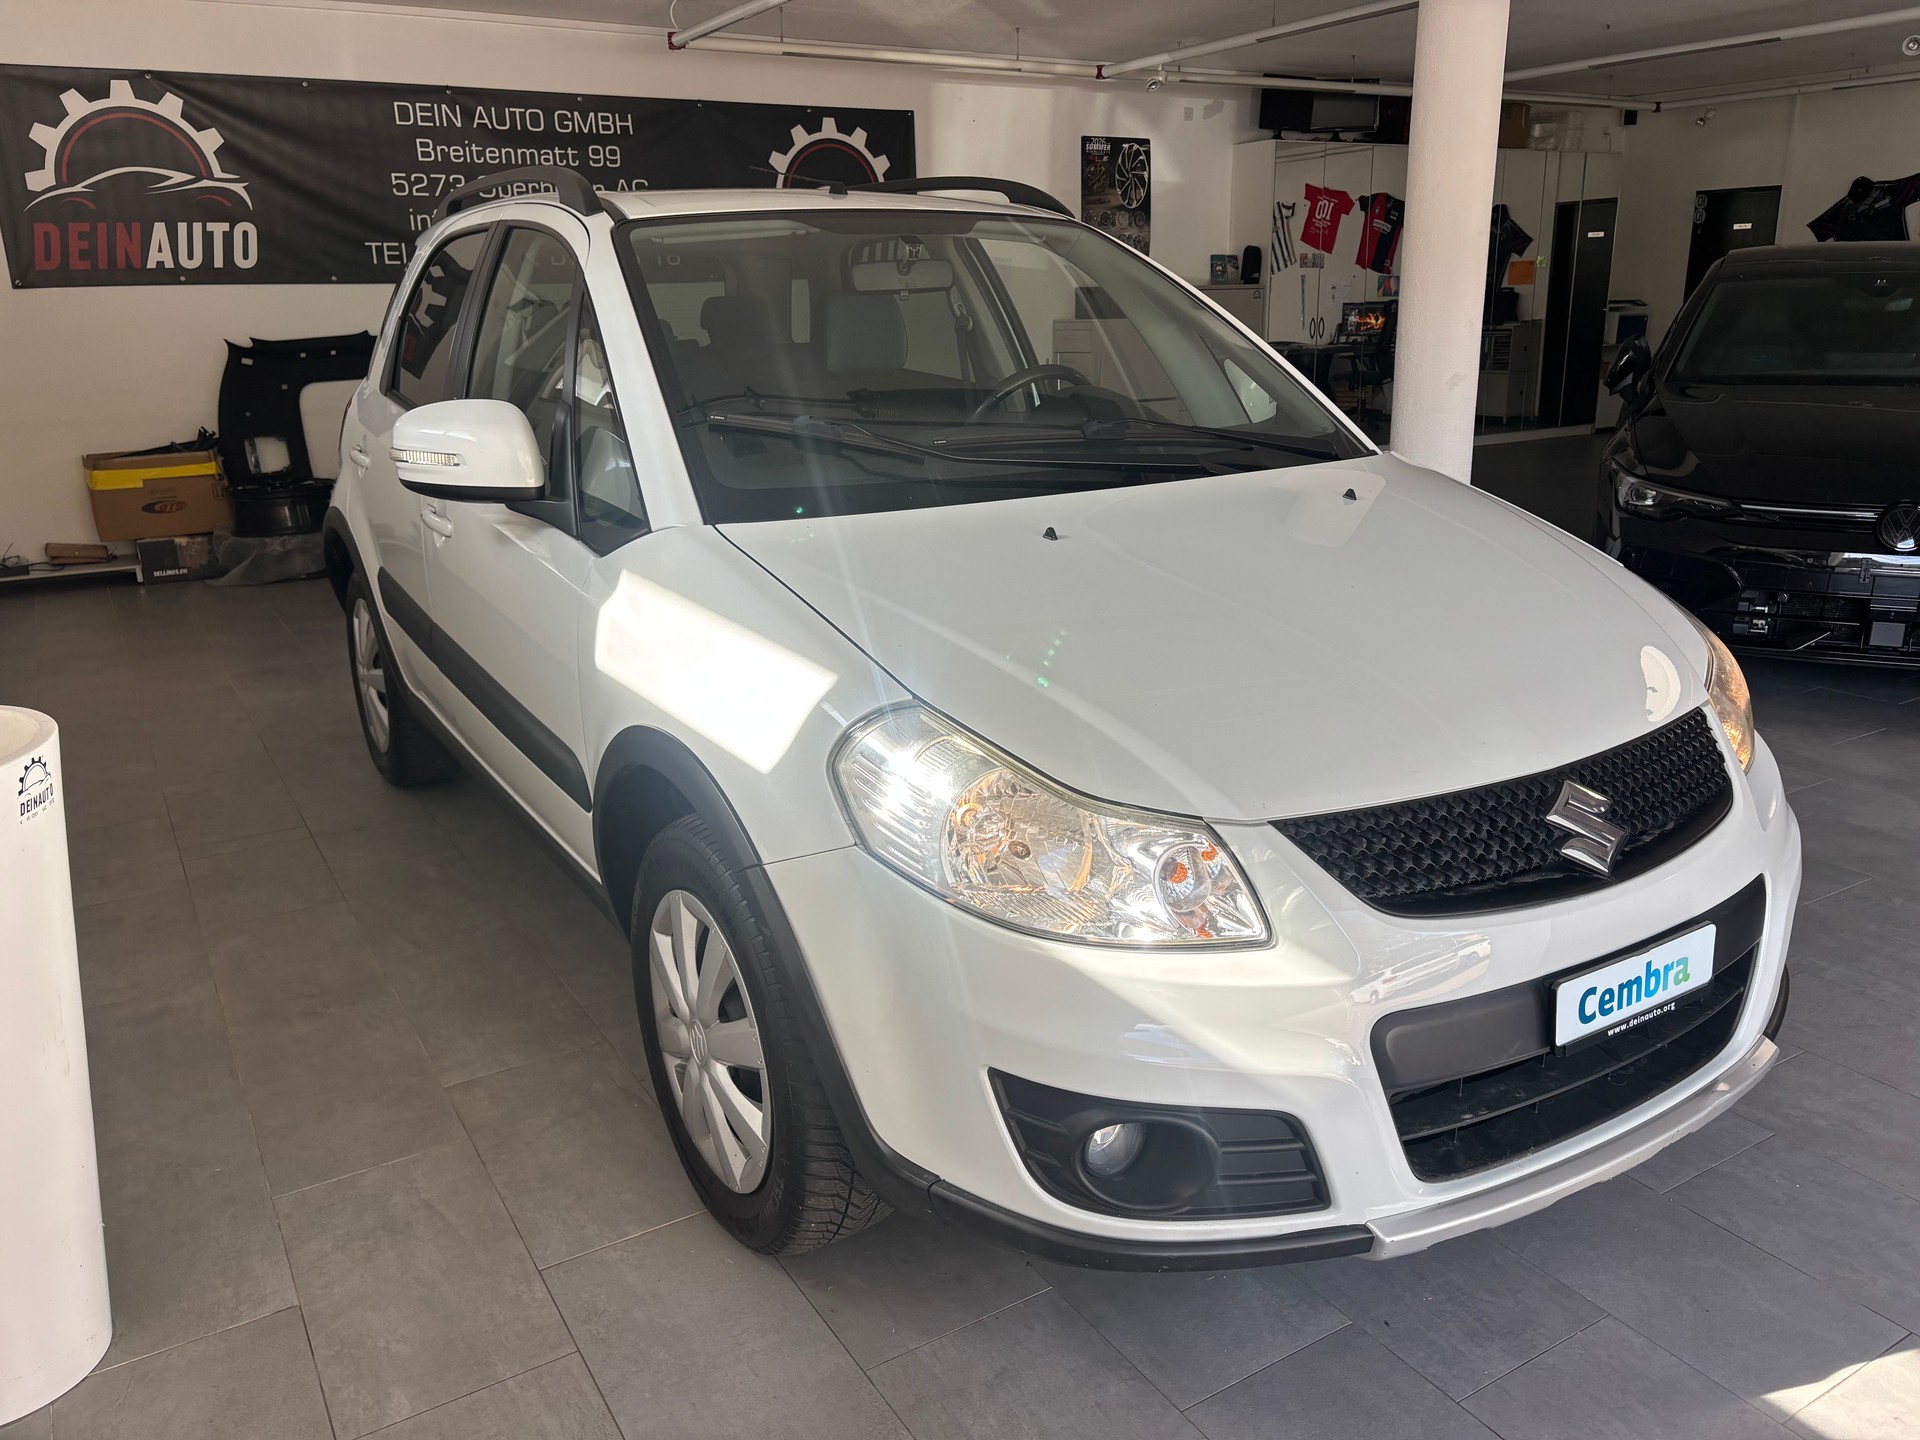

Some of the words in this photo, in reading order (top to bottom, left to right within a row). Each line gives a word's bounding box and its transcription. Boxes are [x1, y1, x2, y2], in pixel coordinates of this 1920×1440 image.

[393, 102, 462, 128] DEIN
[473, 106, 544, 133] AUTO
[554, 111, 634, 135] GMBH
[415, 139, 579, 166] Breitenmatt
[588, 146, 621, 167] 99
[33, 222, 259, 271] DEINAUTO
[20, 783, 54, 817] DEINAUTO
[1578, 957, 1691, 1025] Cembra
[1607, 1002, 1676, 1036] www.deinauto.org
